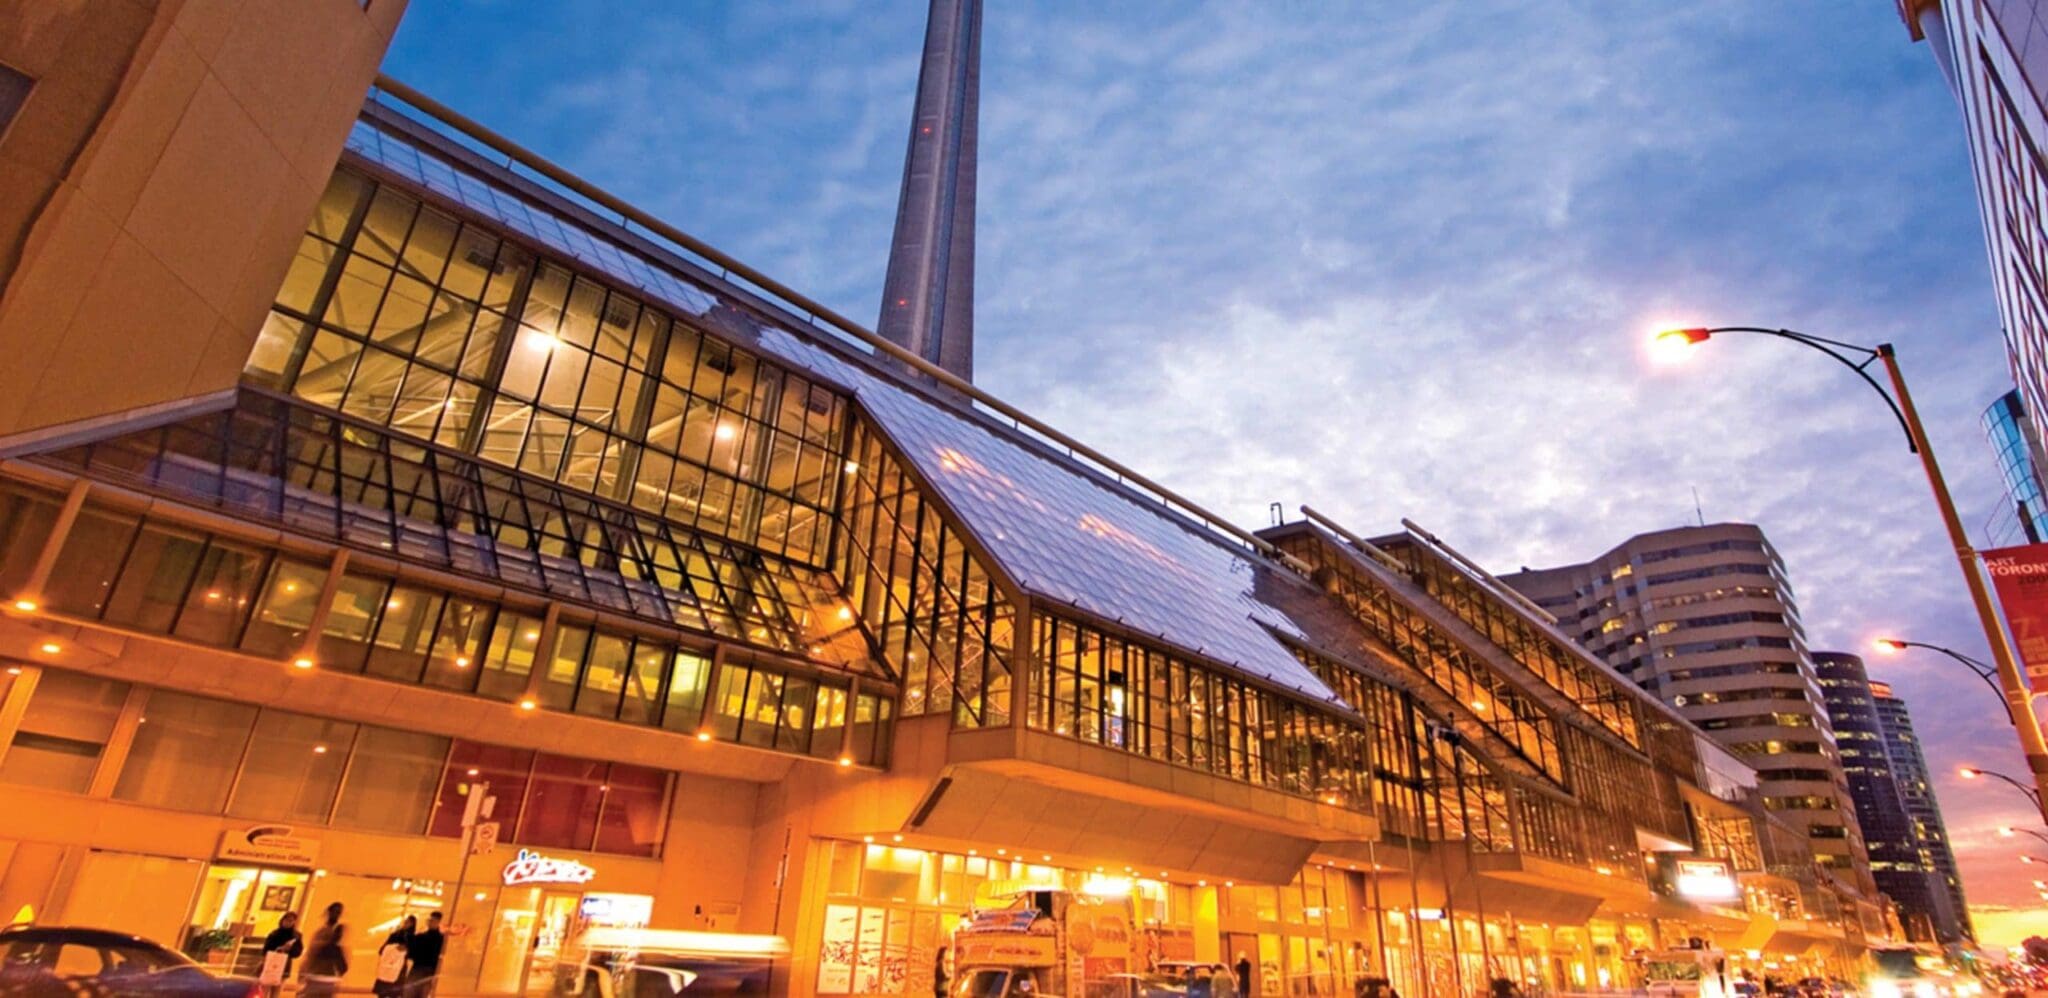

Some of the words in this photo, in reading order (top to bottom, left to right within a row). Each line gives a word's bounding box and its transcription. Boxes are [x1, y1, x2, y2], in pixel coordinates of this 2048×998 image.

[1986, 557, 2015, 567] ART
[227, 848, 287, 860] Administration
[287, 854, 311, 863] Office
